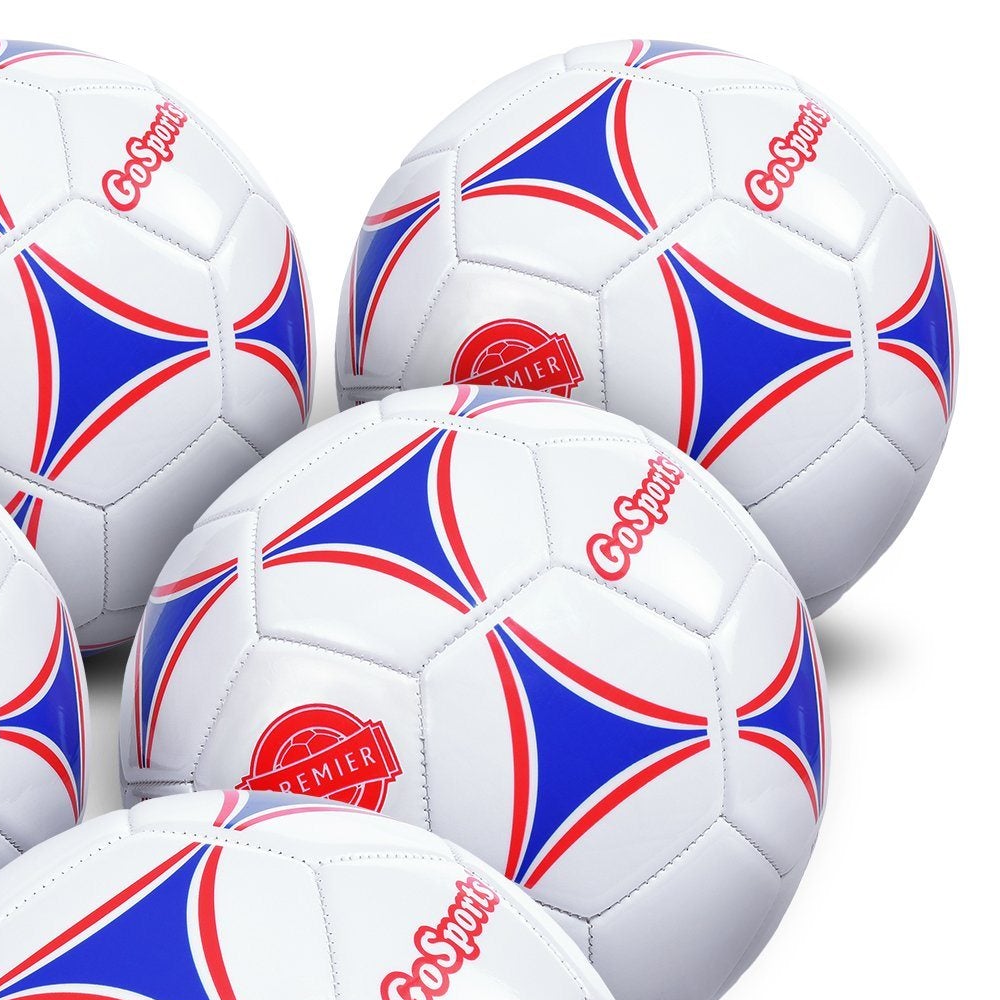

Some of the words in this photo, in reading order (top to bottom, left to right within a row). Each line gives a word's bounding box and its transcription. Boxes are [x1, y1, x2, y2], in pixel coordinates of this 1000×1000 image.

[101, 102, 188, 213] GoSports
[744, 101, 831, 213] GoSports
[490, 356, 560, 387] MIER
[586, 456, 684, 582] GoSports
[270, 746, 376, 794] REMIER
